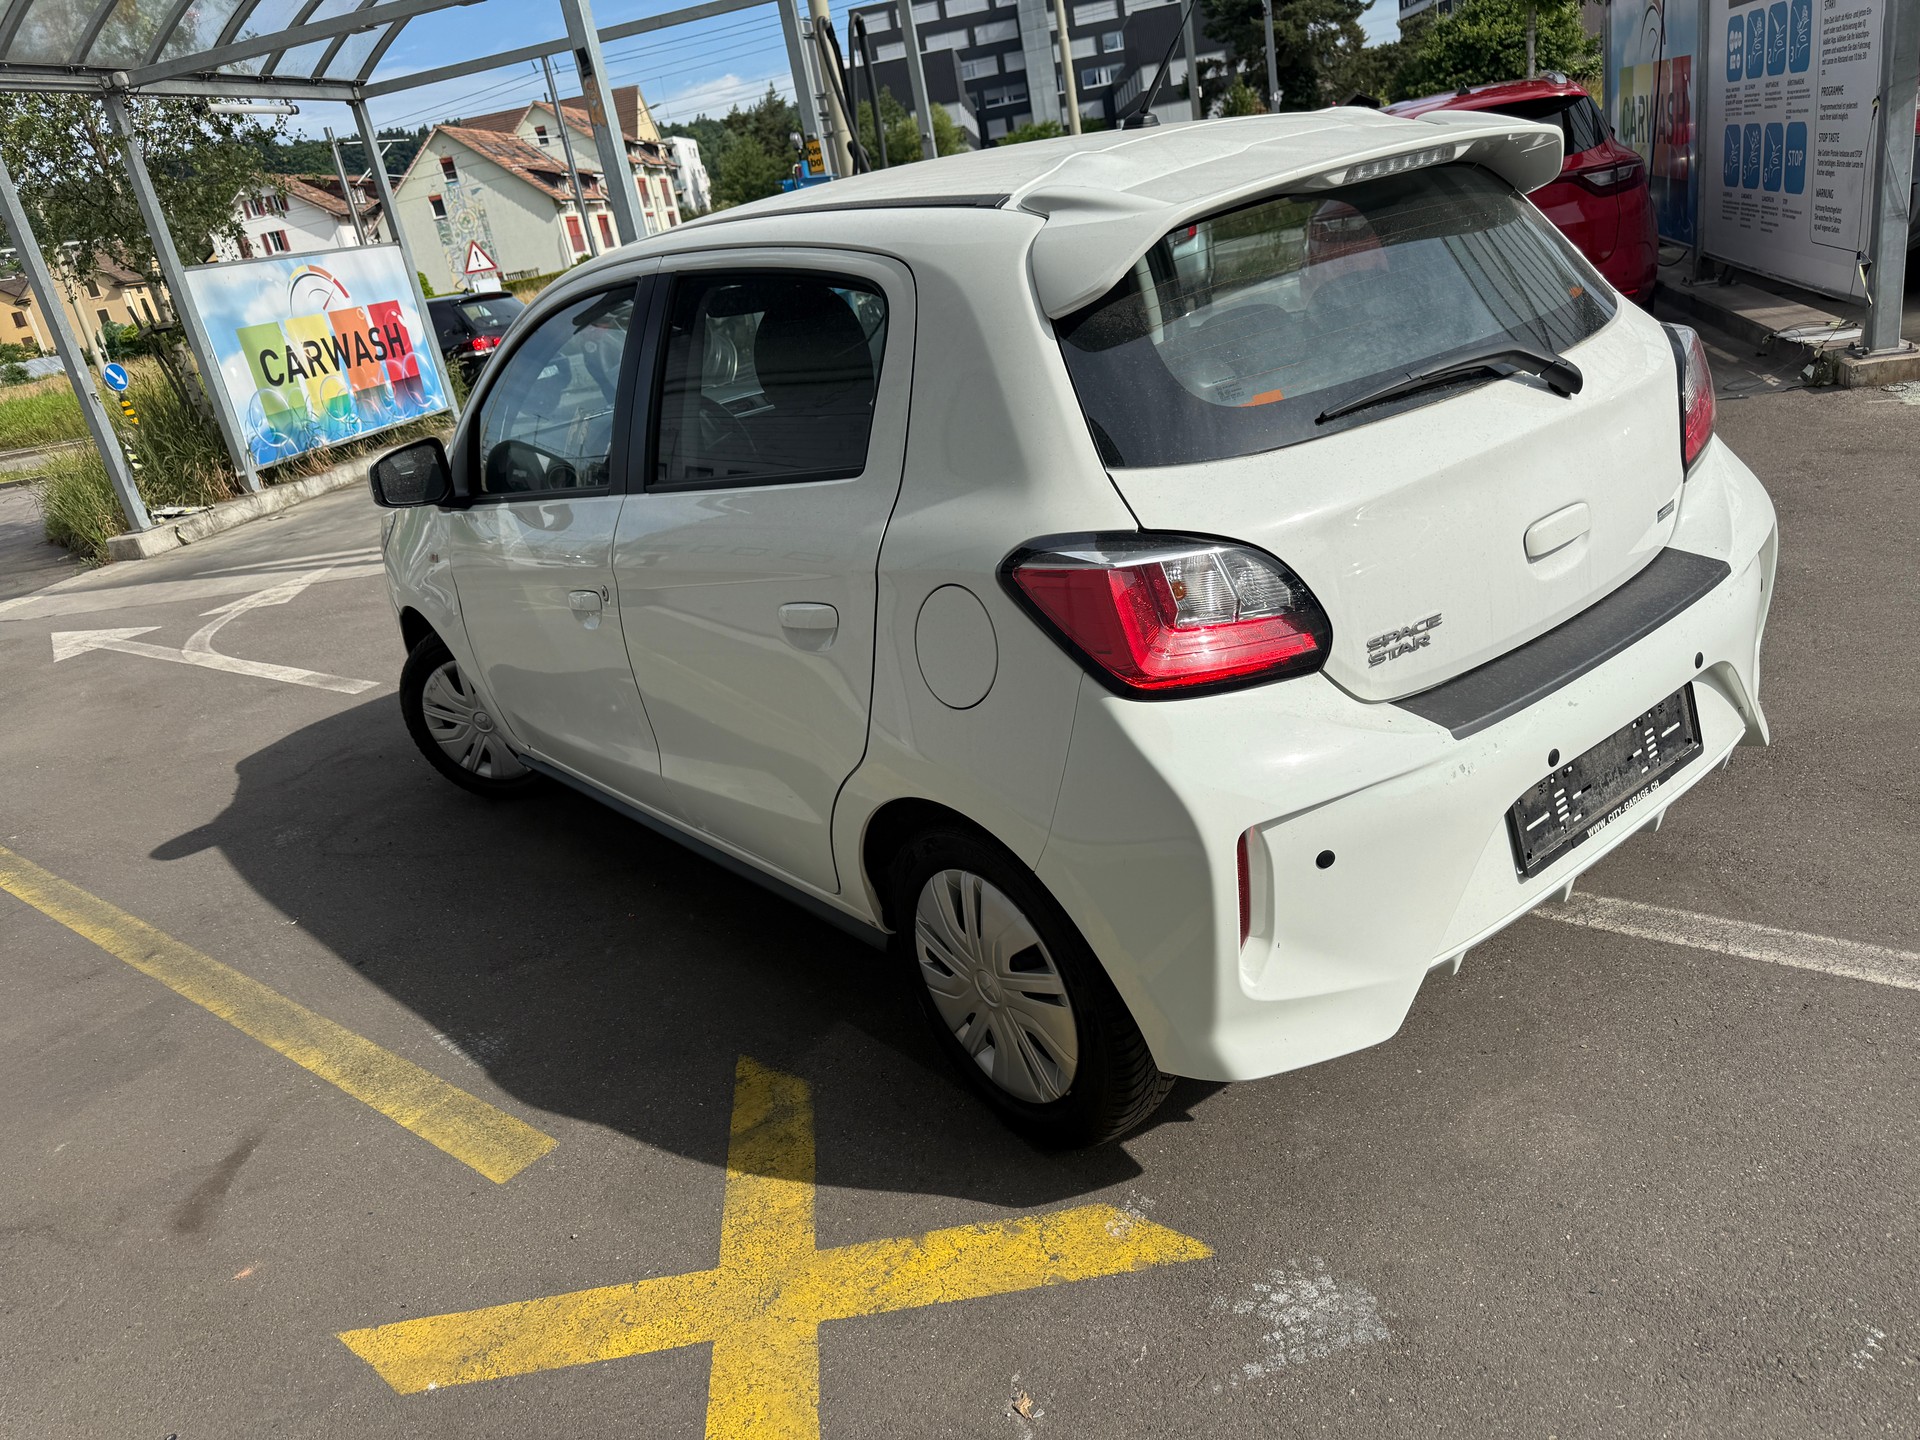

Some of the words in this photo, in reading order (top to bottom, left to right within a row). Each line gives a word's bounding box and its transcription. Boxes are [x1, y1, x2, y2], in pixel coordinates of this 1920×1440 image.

[1768, 48, 1771, 64] 2
[1790, 46, 1794, 62] 3
[1821, 85, 1844, 96] PROGRAMME
[1819, 132, 1828, 143] STOP
[1829, 132, 1840, 143] TASTE
[1788, 150, 1804, 166] STOP
[1764, 168, 1768, 183] 6
[1816, 188, 1834, 199] WARNUNG
[260, 322, 406, 386] CARWASH
[1366, 612, 1443, 653] SPACE
[1368, 634, 1431, 669] STAR
[1586, 779, 1660, 838] WWW.CITY-GARAGE.CH
